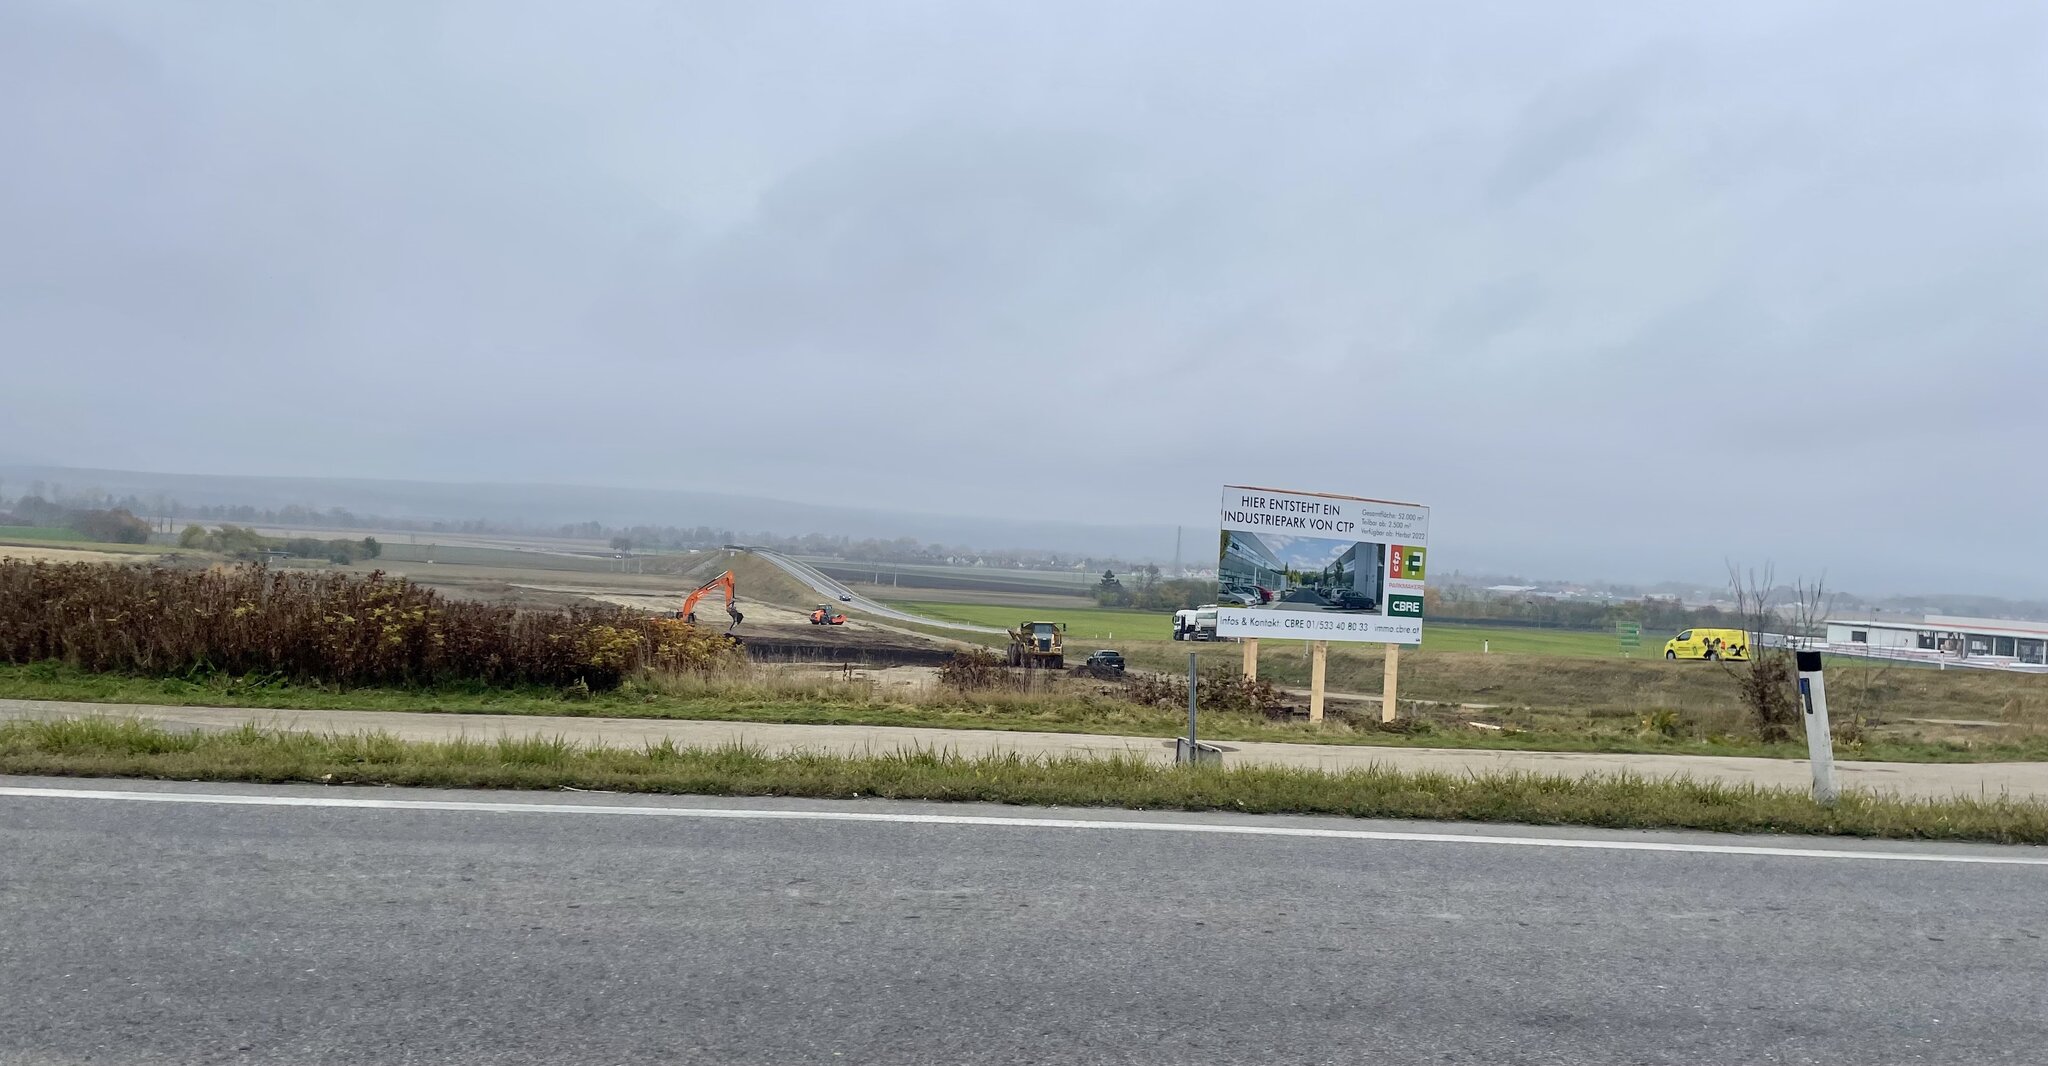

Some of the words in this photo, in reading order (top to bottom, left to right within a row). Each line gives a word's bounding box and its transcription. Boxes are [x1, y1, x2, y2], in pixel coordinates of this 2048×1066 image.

[1241, 496, 1266, 509] HIER
[1270, 498, 1320, 514] ENTSTEHT
[1324, 504, 1340, 516] EIN
[1224, 510, 1306, 528] INDUSTRIEPARK
[1310, 518, 1334, 530] VON
[1336, 521, 1354, 533] CTP
[1398, 512, 1416, 520] 52.000
[1392, 551, 1401, 572] ctp
[1392, 601, 1420, 613] CBRE
[1220, 616, 1238, 626] Infos
[1284, 619, 1304, 629] CBRE
[1306, 620, 1333, 630] 01/533
[1336, 622, 1346, 630] 40
[1348, 622, 1357, 631] 80
[1359, 623, 1368, 632] 33
[1374, 624, 1420, 634] immo.cbre.at
